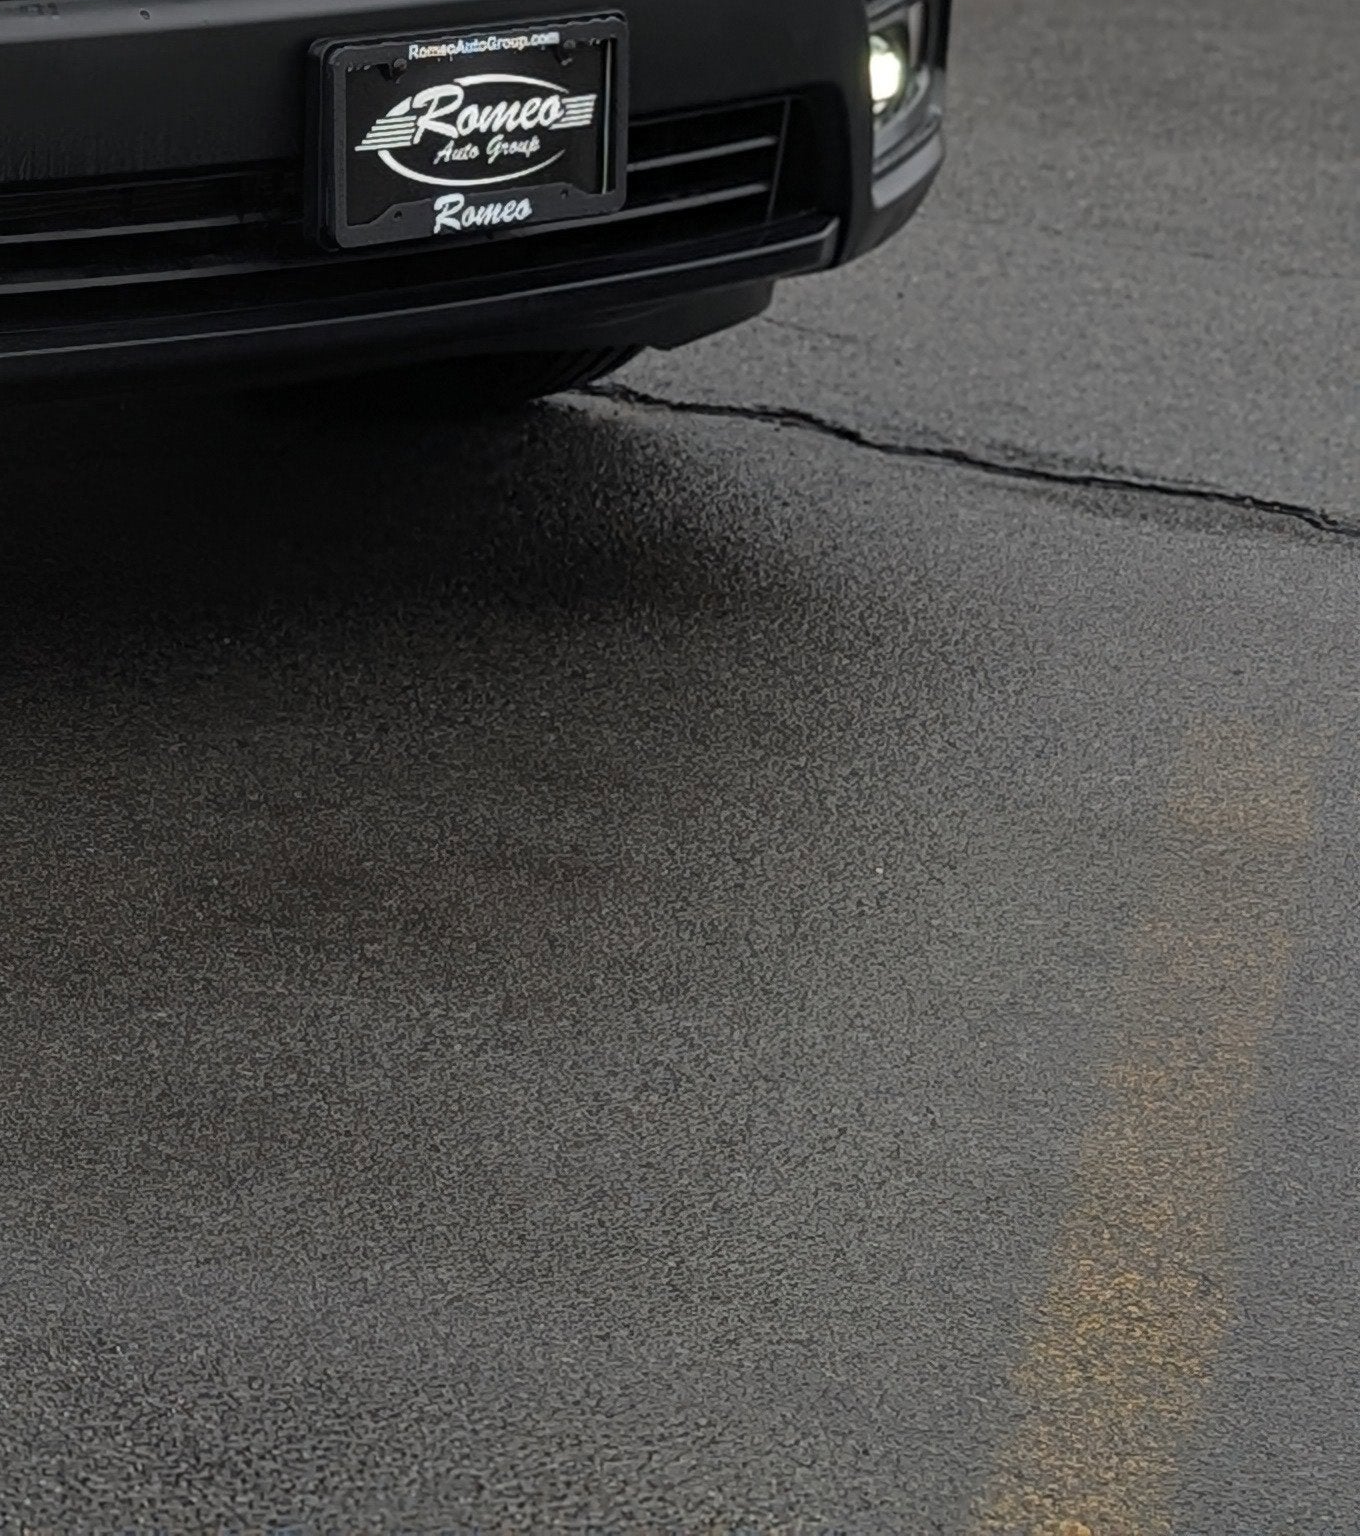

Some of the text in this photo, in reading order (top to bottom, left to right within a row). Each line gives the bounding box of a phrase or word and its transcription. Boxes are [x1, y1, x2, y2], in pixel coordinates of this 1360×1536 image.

[408, 31, 560, 61] RomeoAutoGroup.com
[412, 83, 566, 145] Romeo
[432, 134, 541, 164] Auto Group
[433, 193, 533, 234] Romeo
